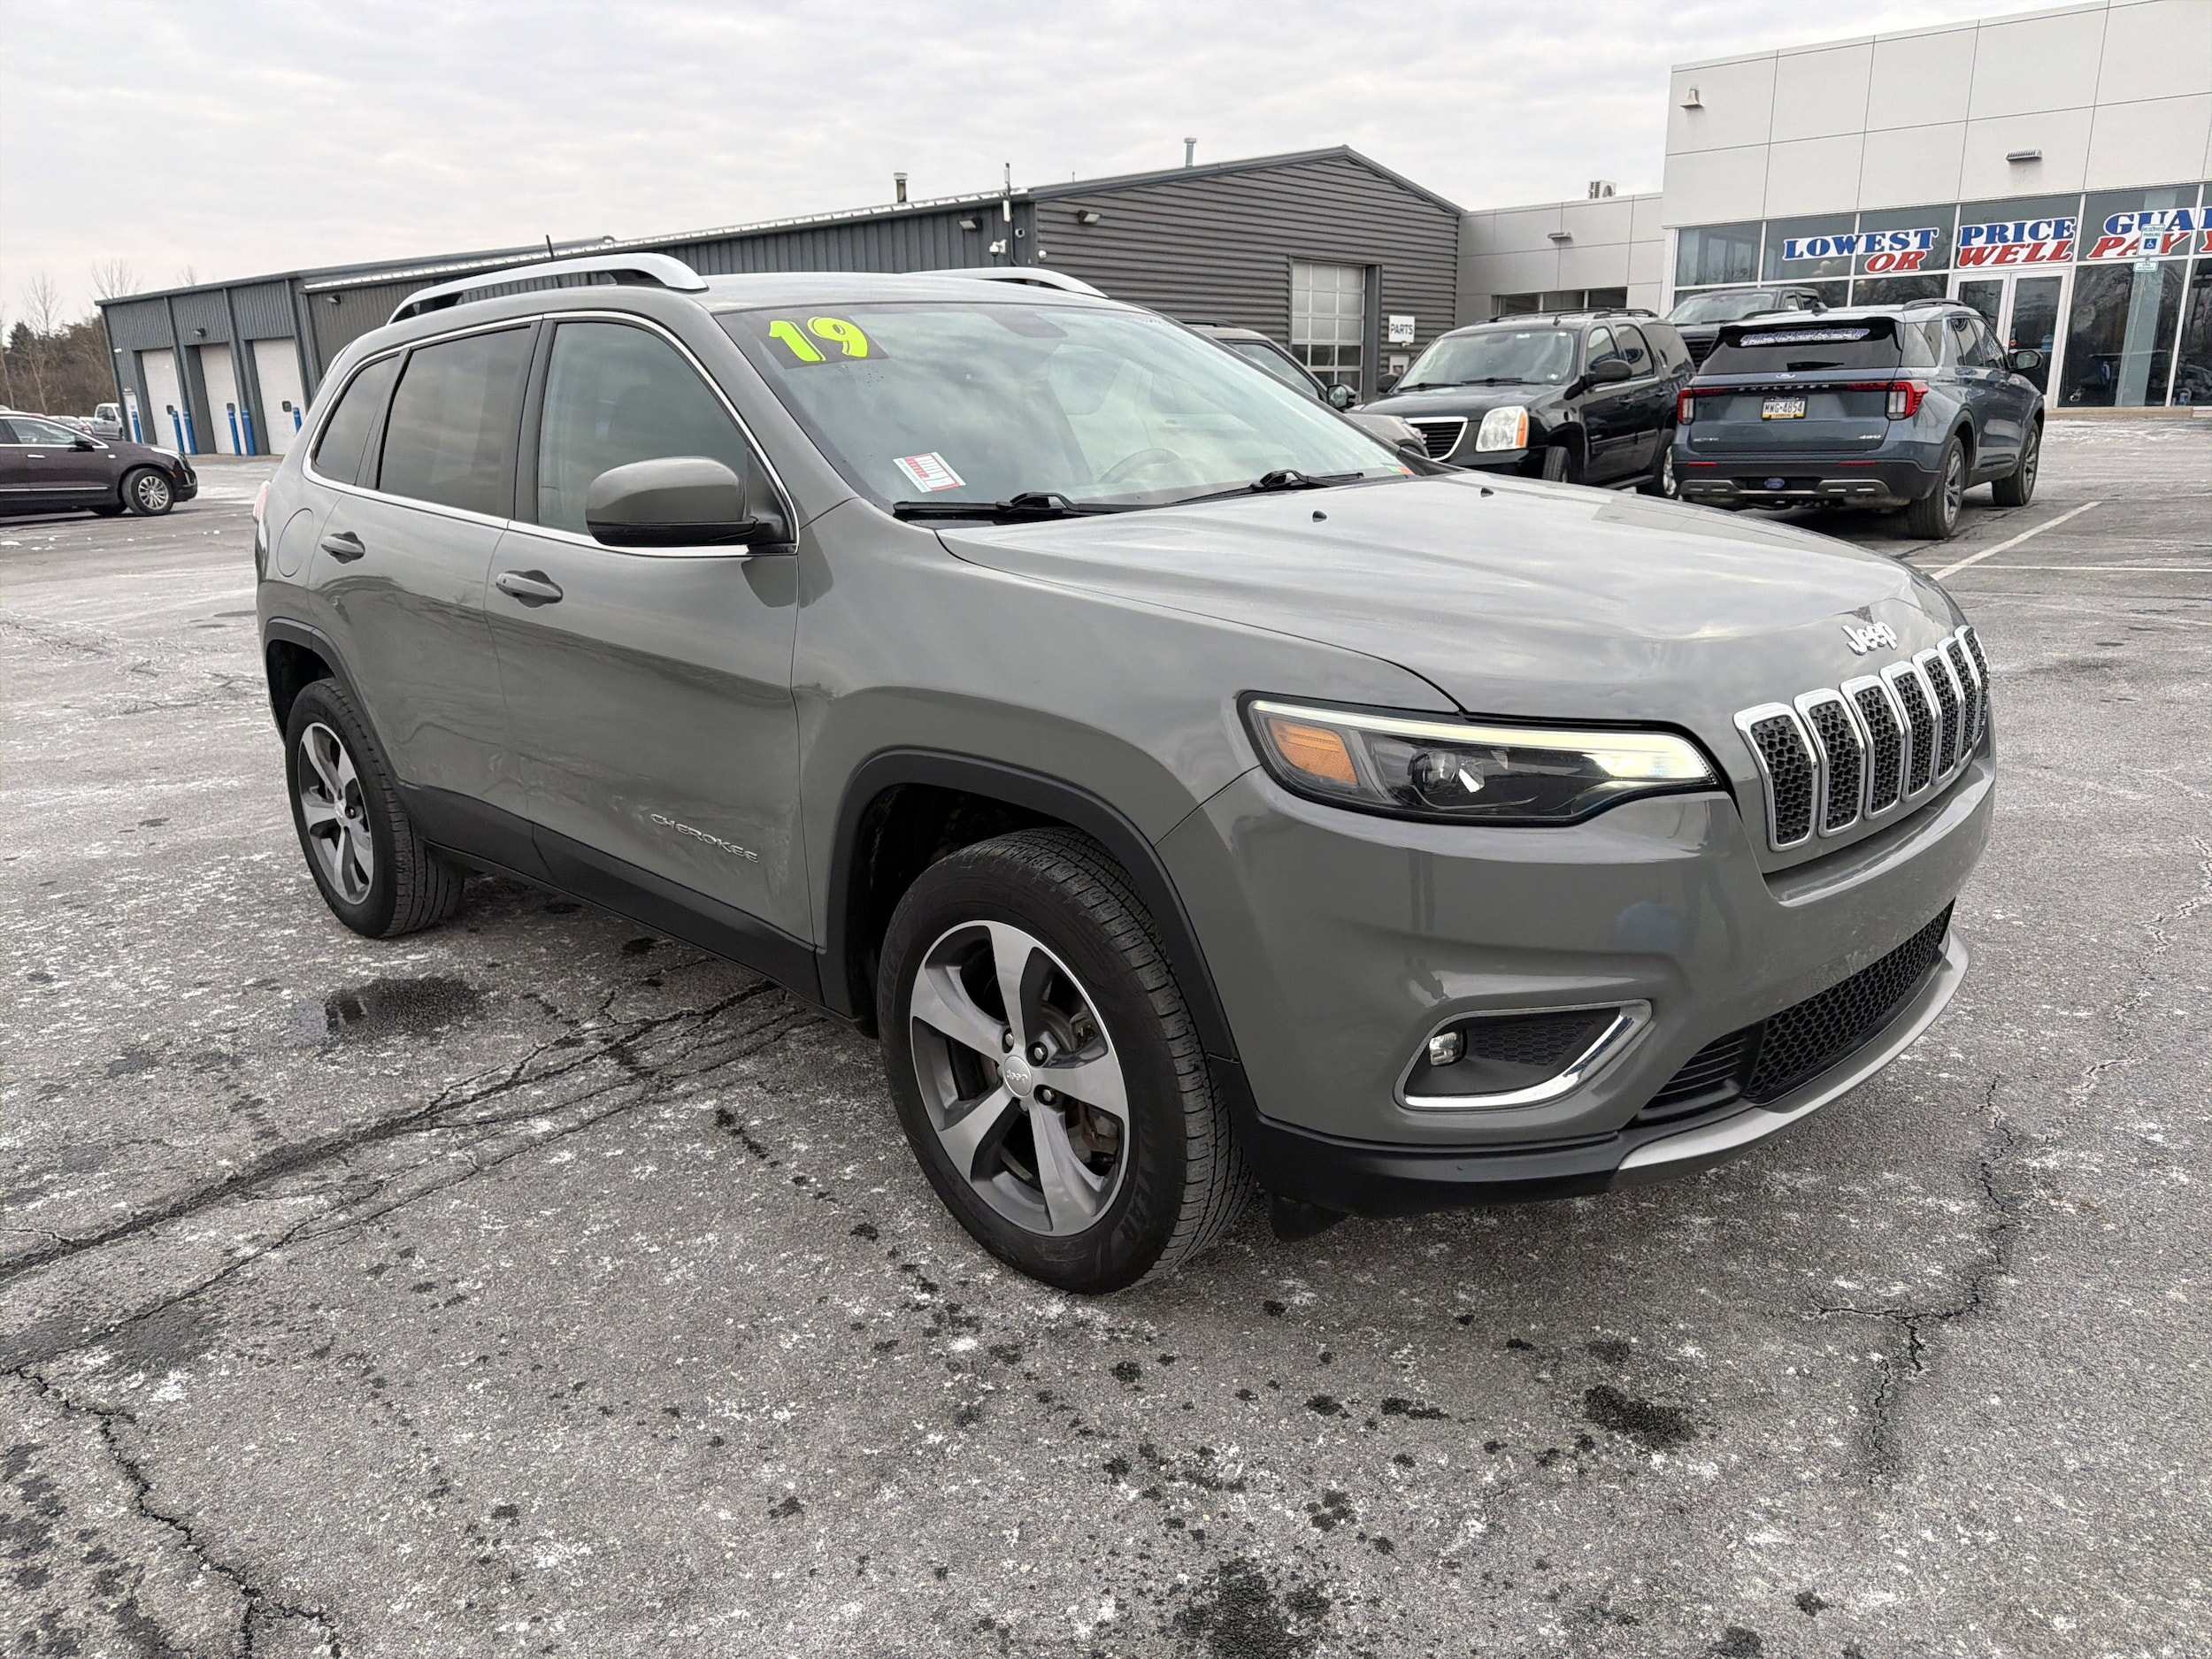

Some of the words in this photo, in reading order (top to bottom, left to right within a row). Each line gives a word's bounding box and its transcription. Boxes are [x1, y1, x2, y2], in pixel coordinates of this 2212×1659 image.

[1783, 228, 1939, 260] LOWEST
[1958, 218, 2076, 247] PRICE
[1865, 250, 1926, 273] OR
[1958, 240, 2072, 266] WE'LL
[768, 316, 869, 363] 19
[1390, 323, 1414, 335] PARTS
[1840, 621, 1898, 656] Jeep
[650, 813, 759, 864] CHEROKEE
